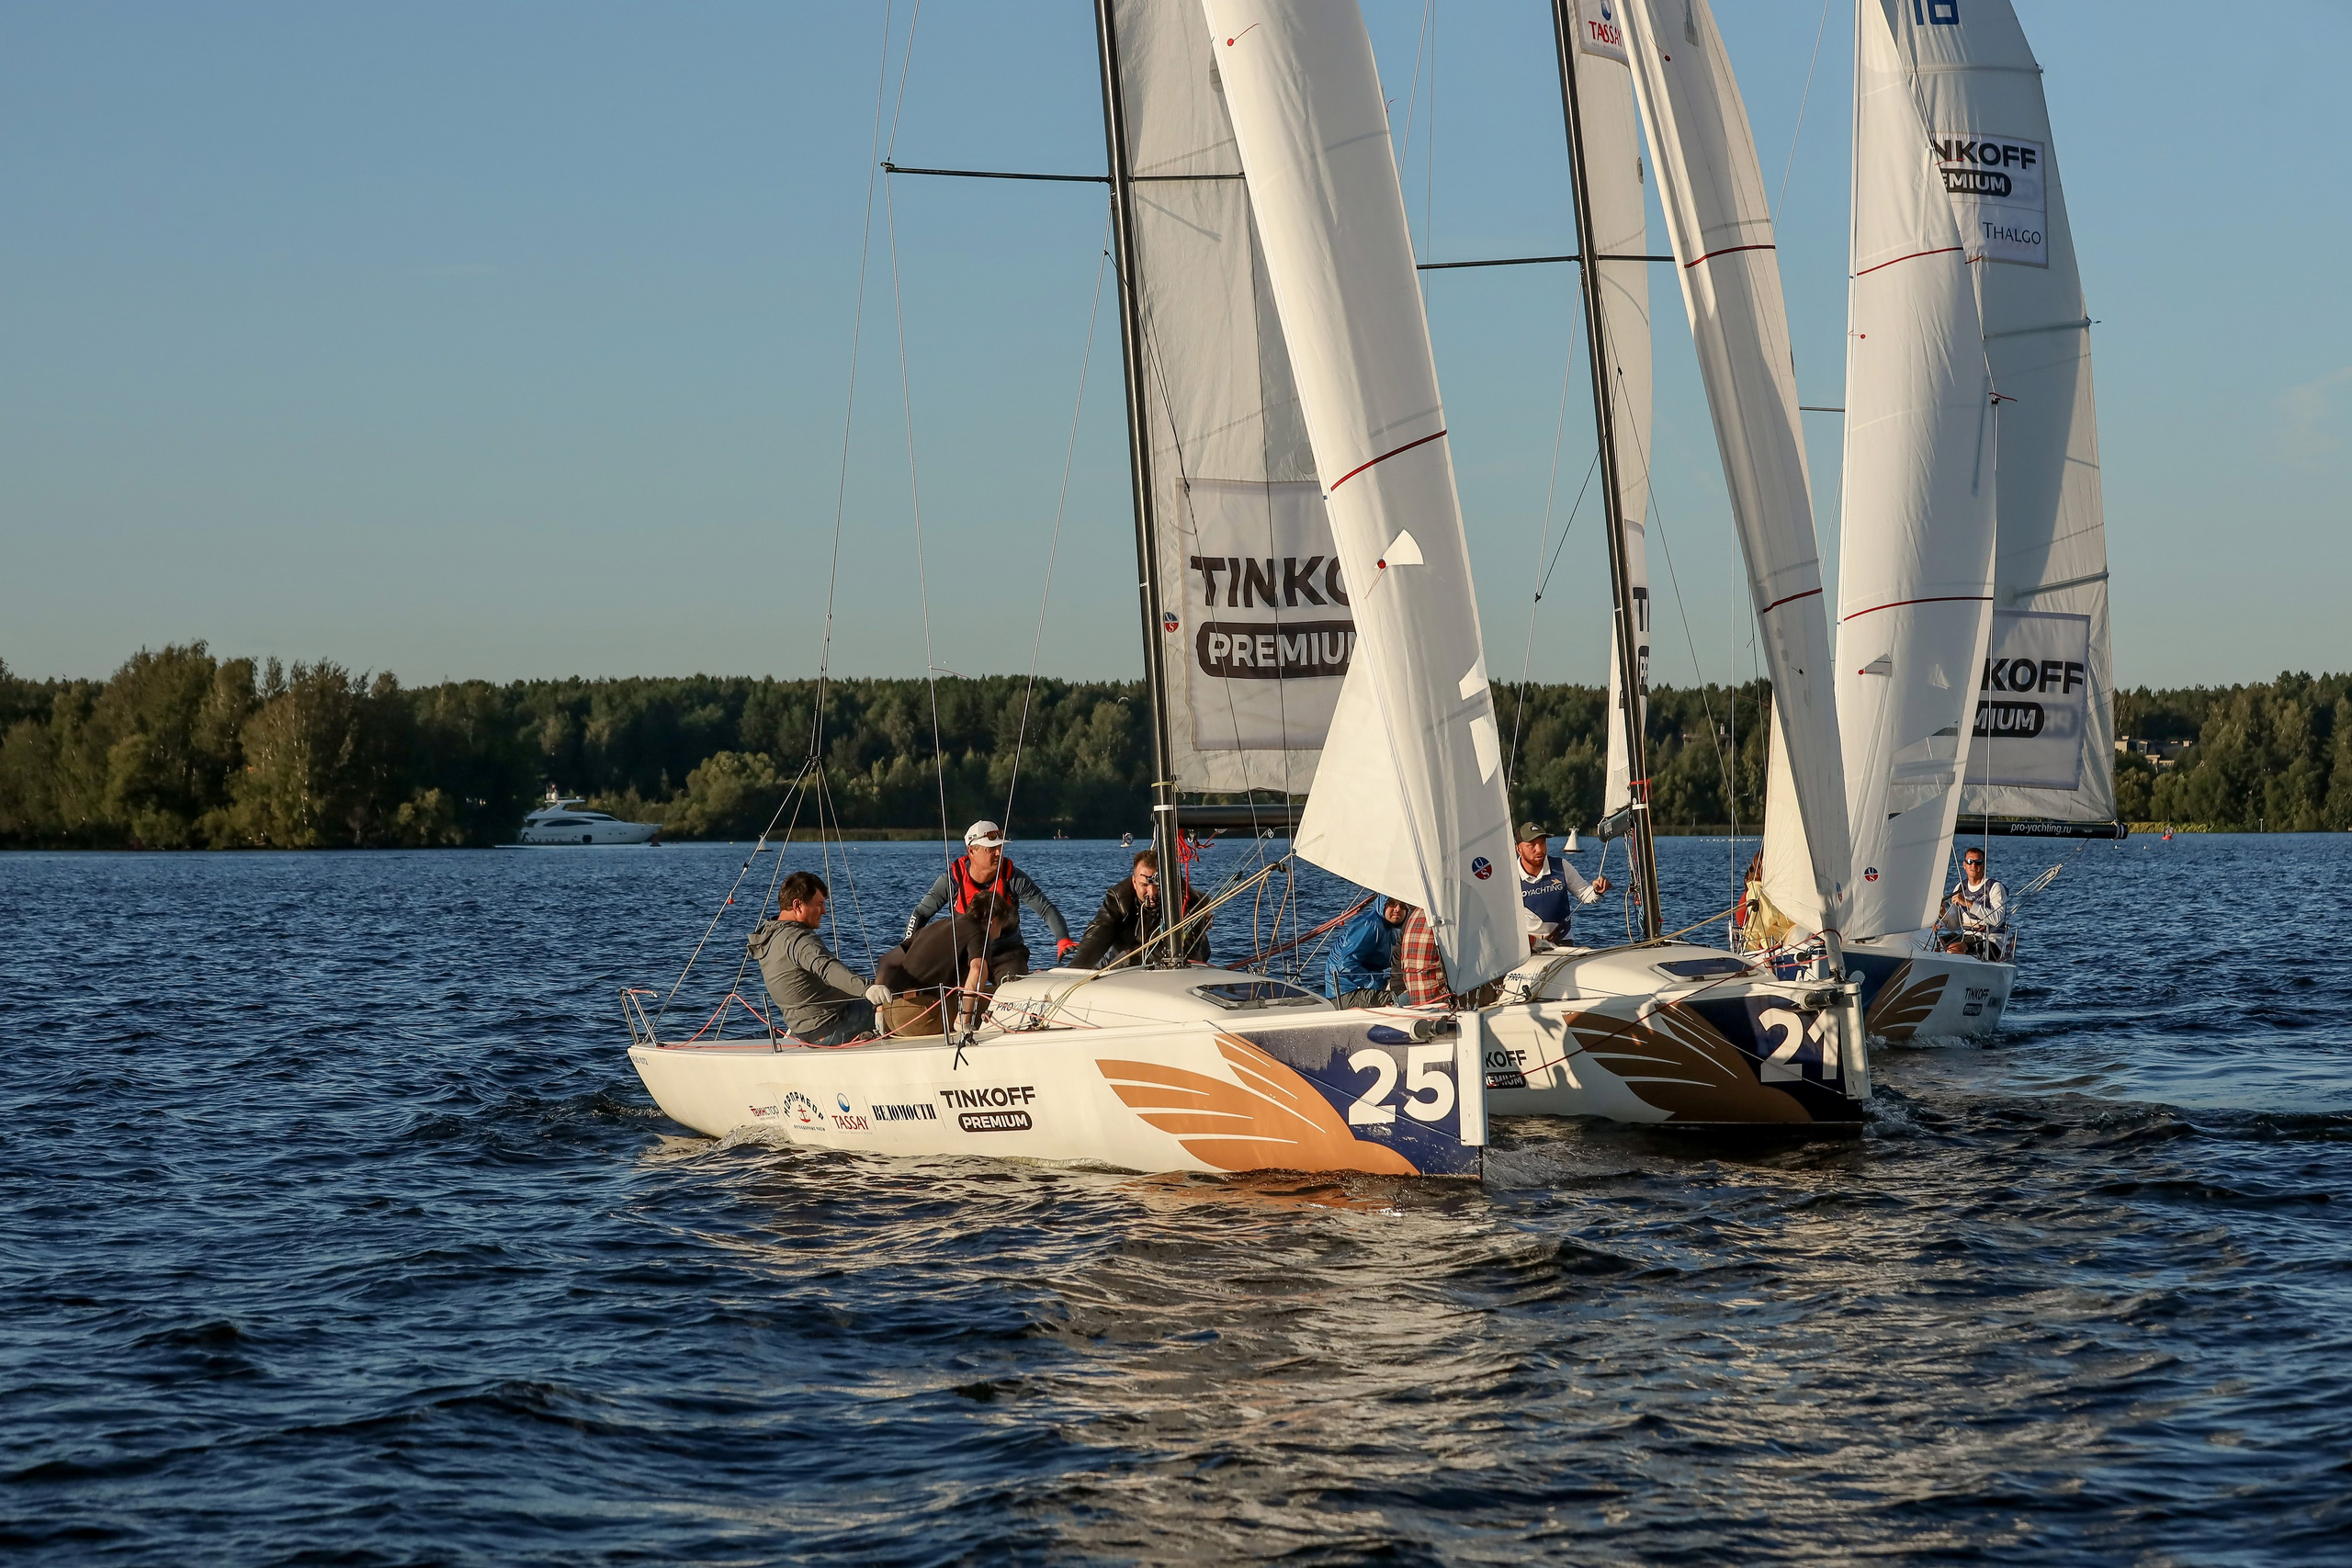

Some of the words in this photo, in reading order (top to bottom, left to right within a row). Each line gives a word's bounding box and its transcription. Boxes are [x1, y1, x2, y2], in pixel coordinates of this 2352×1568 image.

[1930, 139, 2037, 170] NKOFF
[1942, 173, 2006, 193] MIUM
[1982, 221, 2041, 245] THALGO
[1191, 556, 1350, 607] TINK
[1981, 658, 2084, 694] KOFF
[1974, 707, 2037, 731] MIUM
[2010, 822, 2072, 835] pro-yachting.ru
[1521, 884, 1564, 897] OYACHTING
[903, 914, 917, 942] OTEST
[1758, 1008, 1839, 1082] 21
[1486, 1050, 1527, 1067] KOFF
[1347, 1043, 1455, 1125] 25
[1486, 1075, 1523, 1086] EMIUM
[784, 1091, 824, 1118] МОРПРИБОР
[940, 1086, 1035, 1109] TINKOFF
[831, 1115, 869, 1130] TASSAY
[872, 1104, 937, 1122] ВЕДОМОСТИ
[961, 1113, 1029, 1130] PREMIUM
